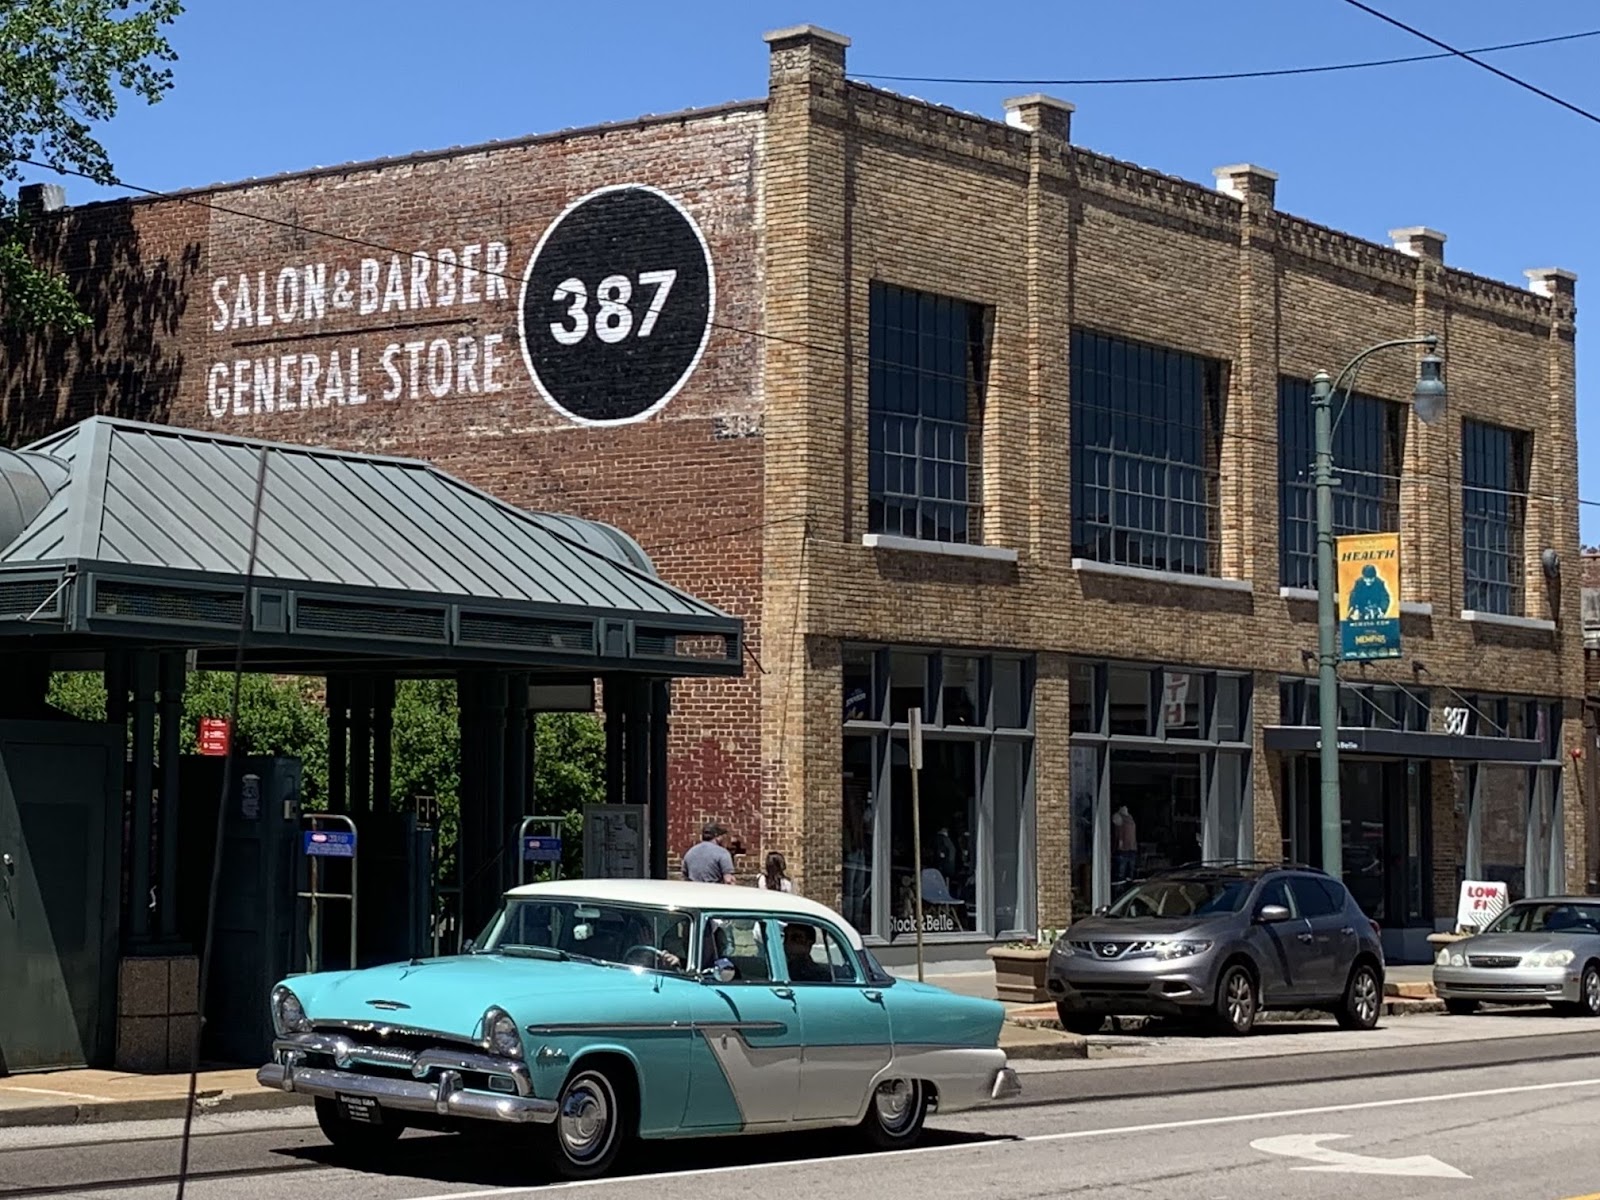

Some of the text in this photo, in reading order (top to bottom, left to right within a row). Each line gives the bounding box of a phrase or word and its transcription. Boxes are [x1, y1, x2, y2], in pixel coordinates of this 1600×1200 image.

[550, 269, 677, 345] 387
[208, 334, 503, 418] GENERAL STORE
[1341, 550, 1395, 562] HEALTH
[1444, 707, 1469, 735] 387
[1468, 886, 1498, 898] LOW
[1474, 900, 1487, 910] FI
